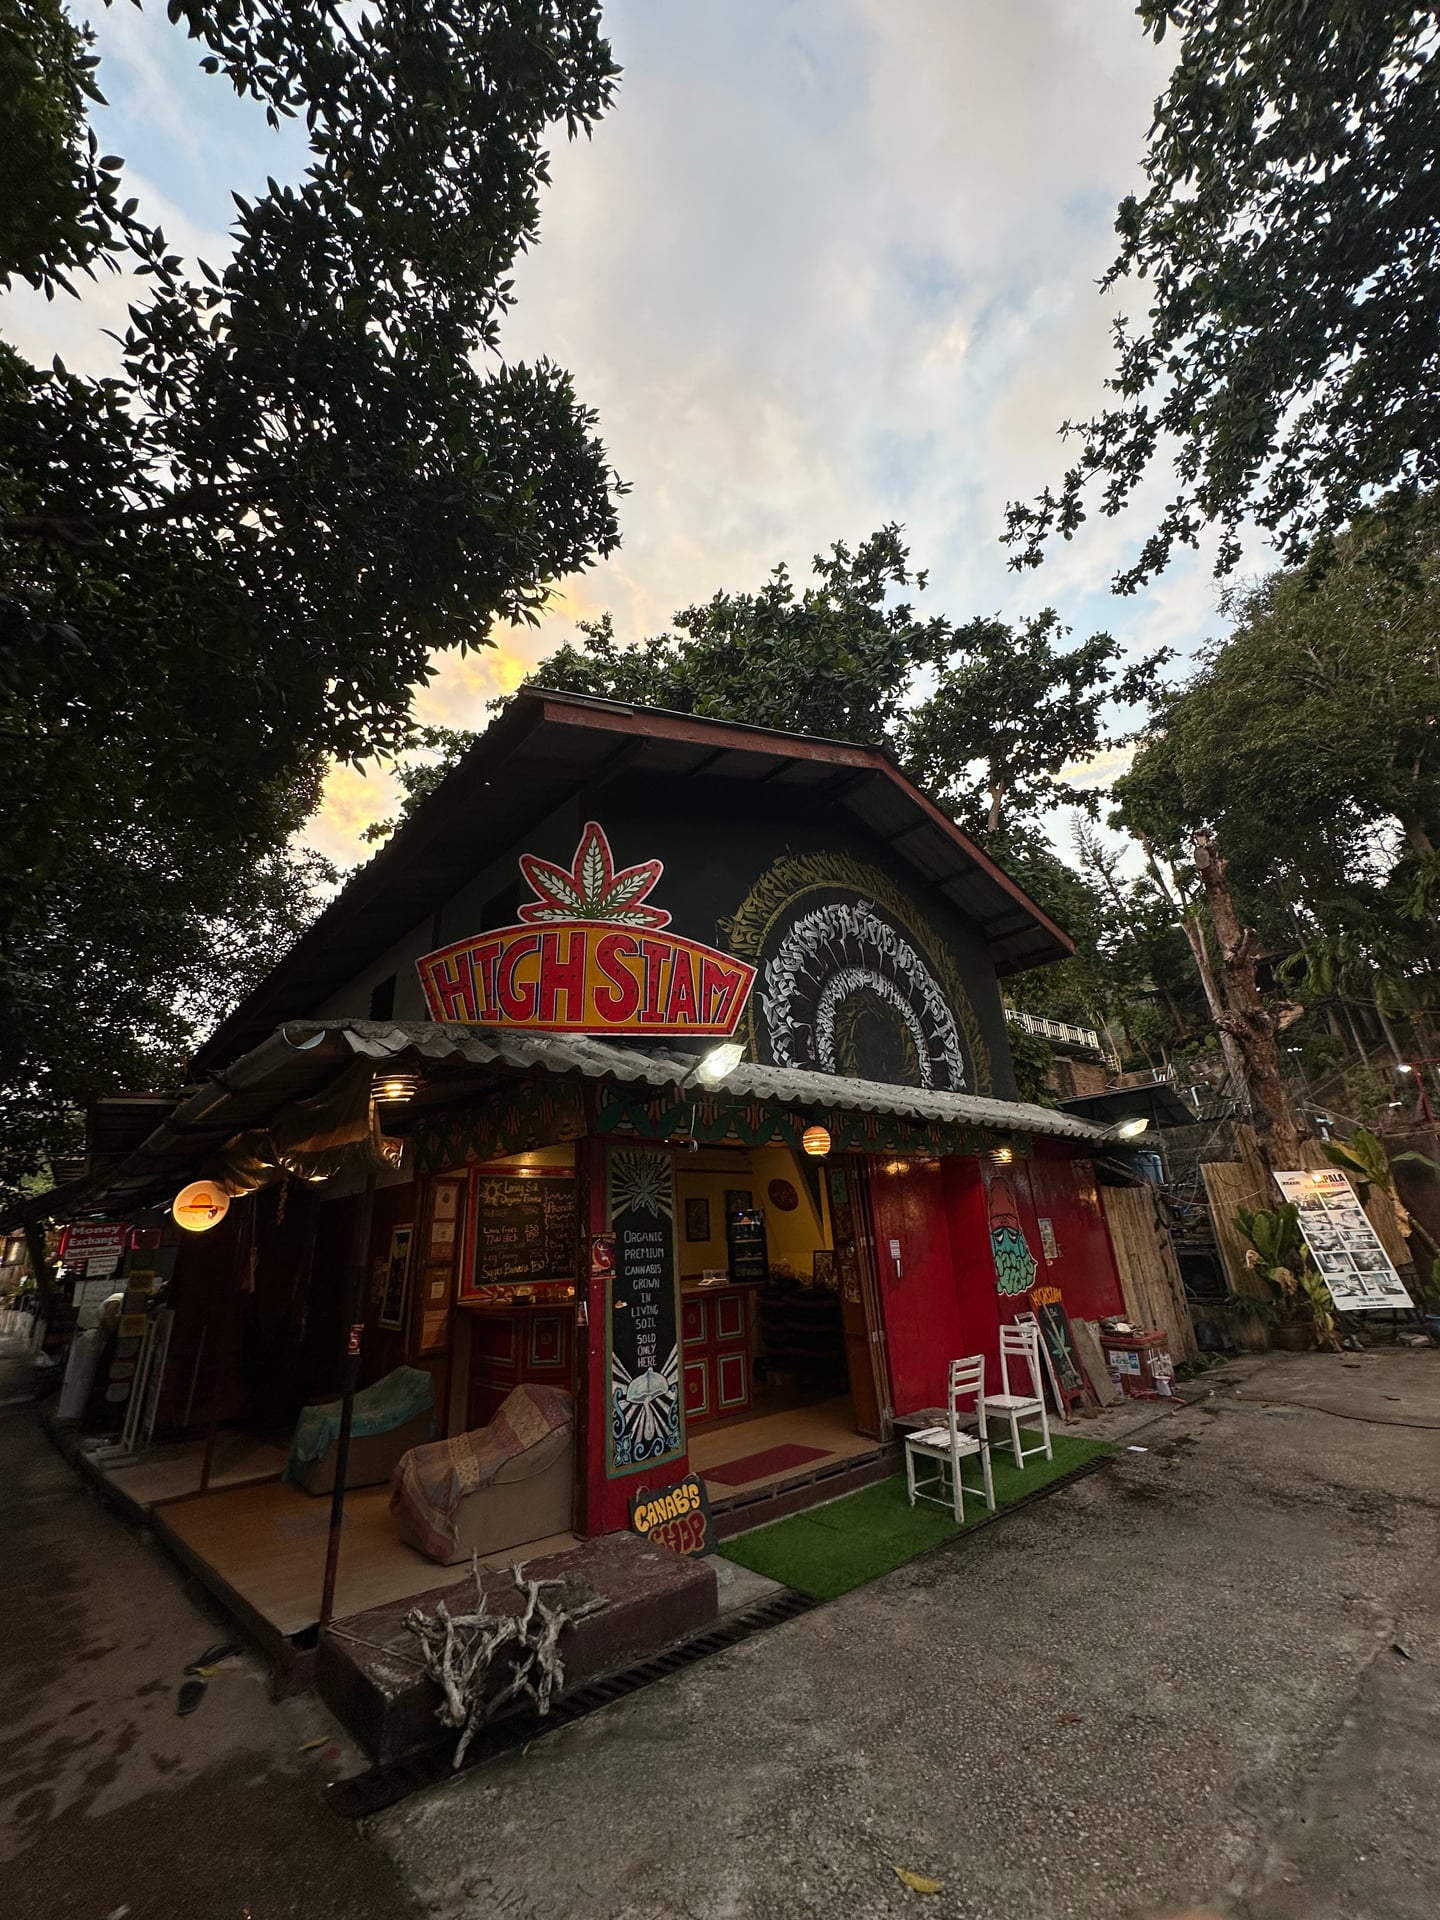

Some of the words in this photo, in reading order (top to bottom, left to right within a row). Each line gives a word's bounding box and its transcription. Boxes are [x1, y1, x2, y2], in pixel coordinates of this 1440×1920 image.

[430, 931, 587, 1022] HIGH
[593, 933, 742, 1024] SIAM
[1312, 1174, 1346, 1184] APALA
[72, 1226, 120, 1235] Money
[624, 1230, 663, 1244] ORGANIC
[68, 1236, 120, 1247] Exchange
[624, 1247, 664, 1261] PREMIUM
[625, 1264, 662, 1276] CANNABIS
[632, 1278, 660, 1290] GROWN
[641, 1292, 652, 1303] IN
[631, 1304, 659, 1317] LIVING
[635, 1317, 657, 1330] SOIL
[636, 1333, 656, 1345] SOLD
[637, 1343, 657, 1356] ONLY
[637, 1355, 657, 1368] HERE
[634, 1484, 700, 1532] CANABIS
